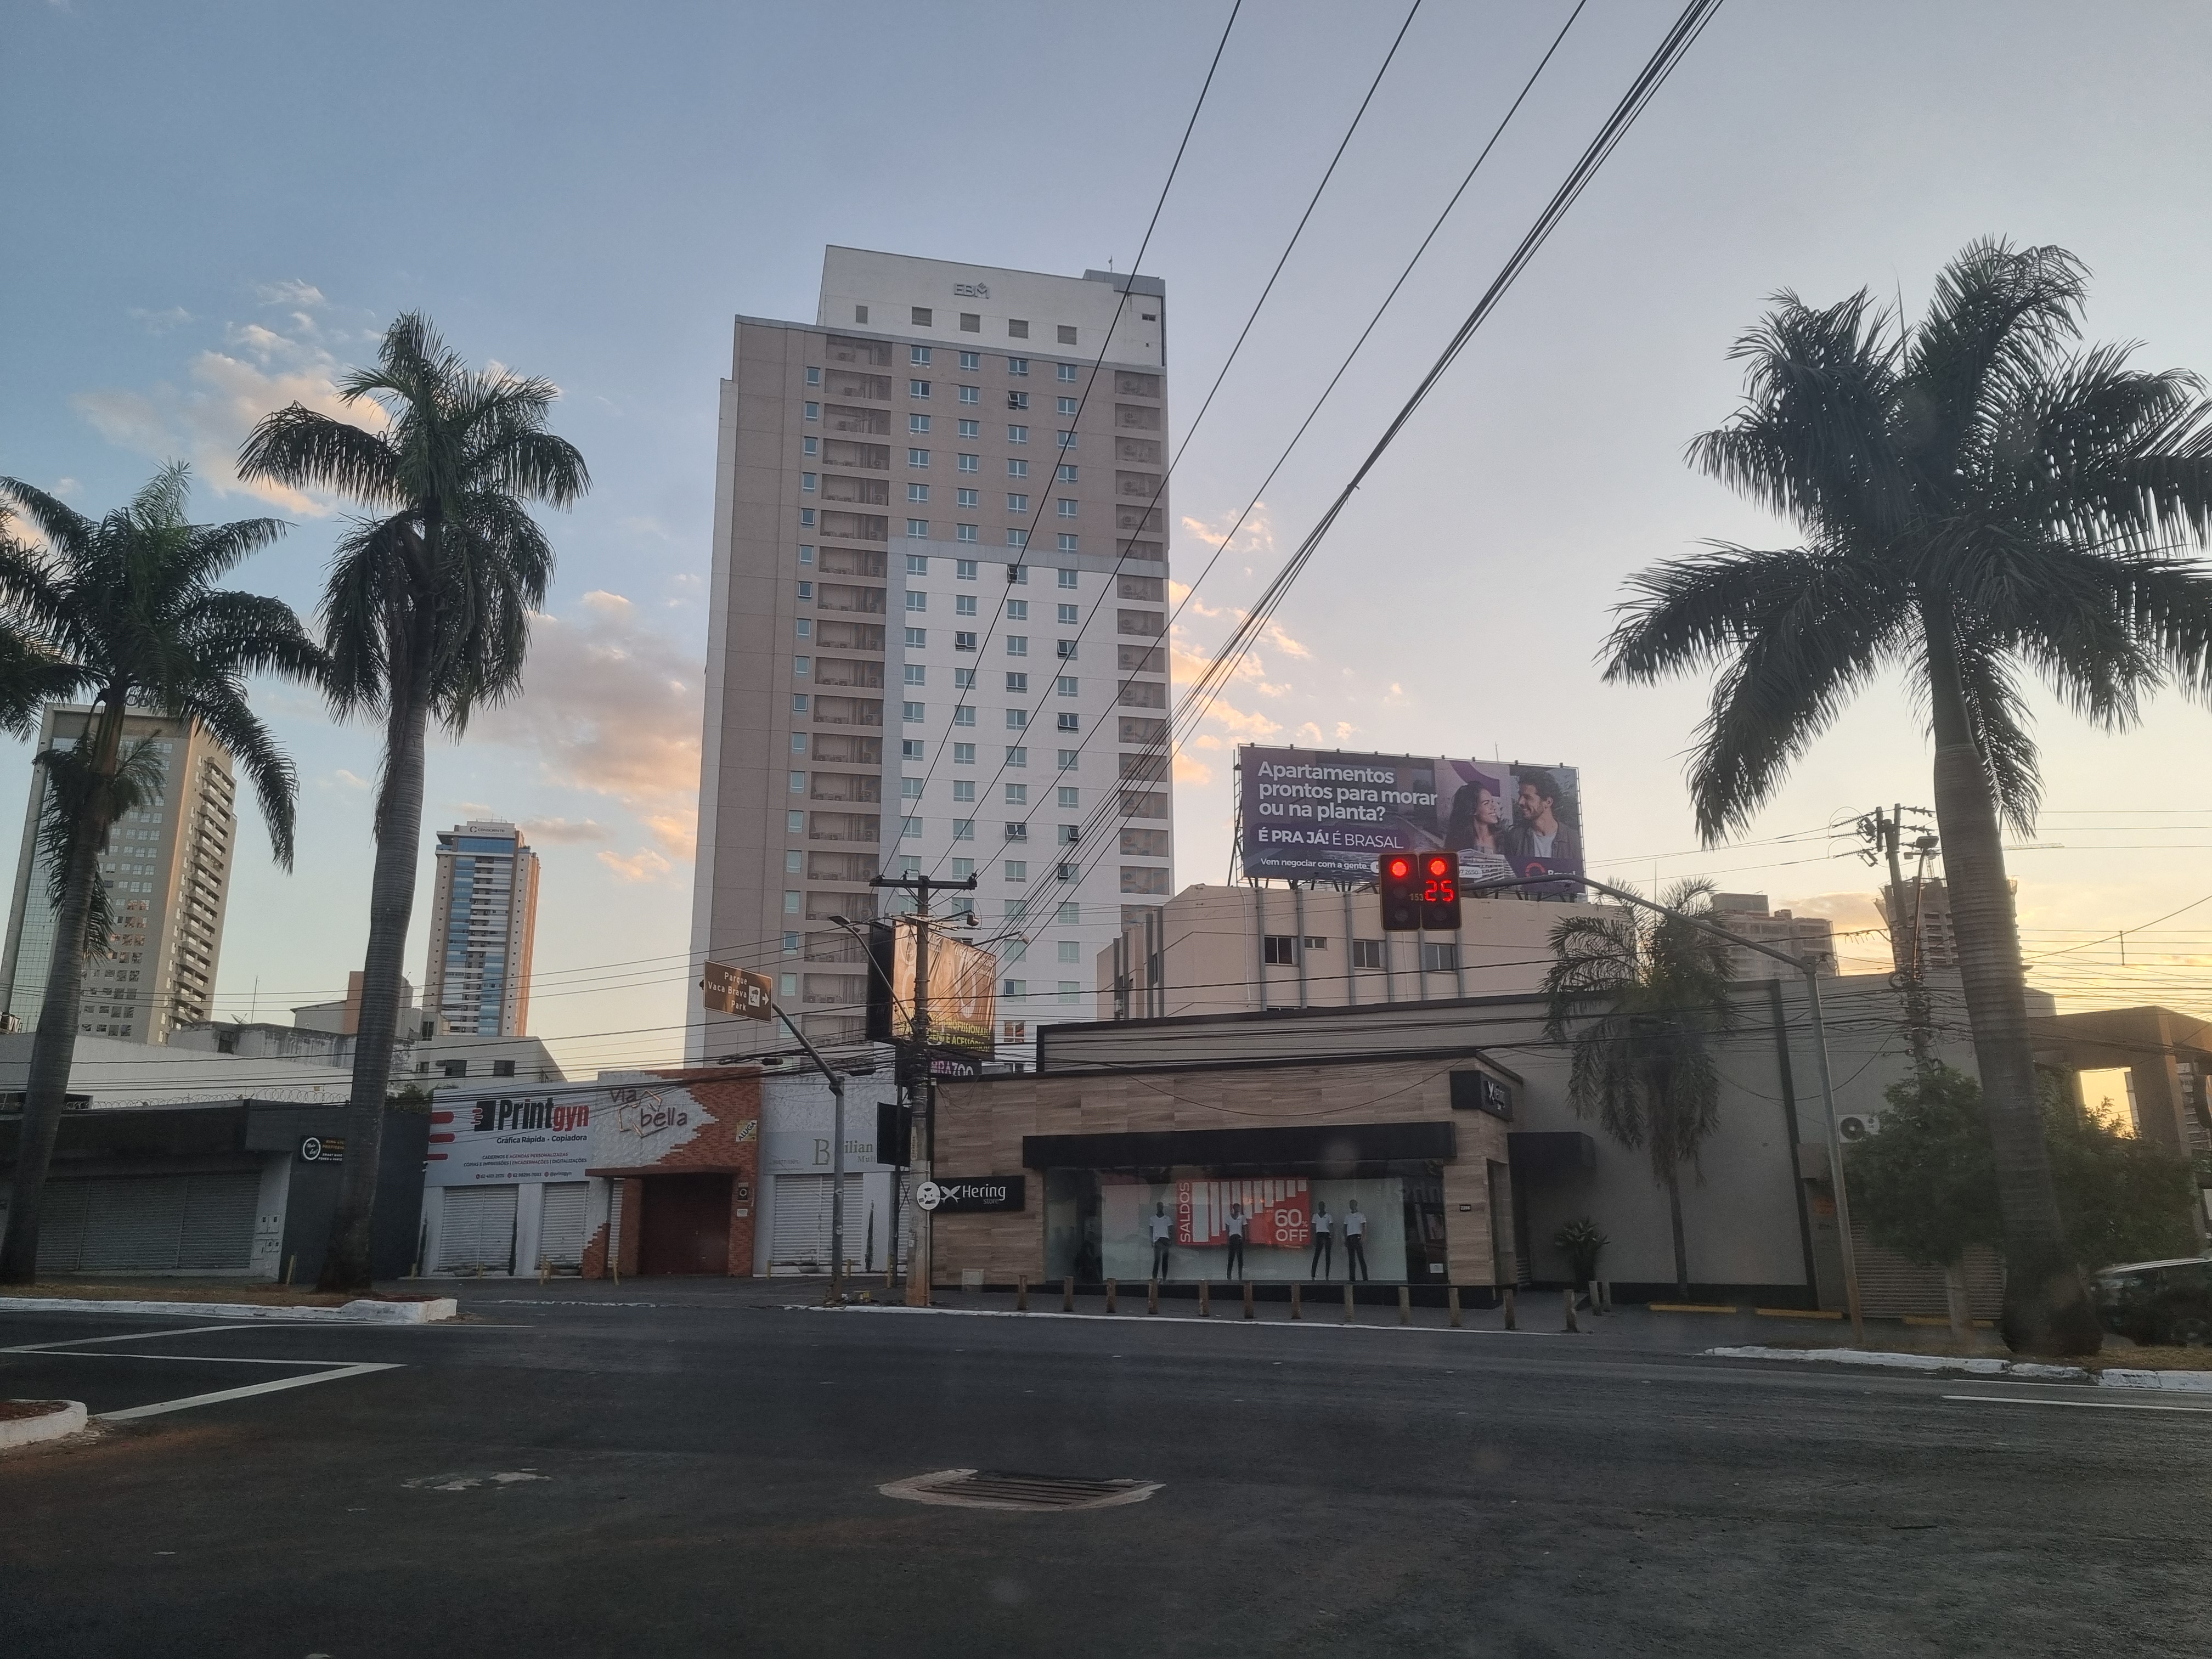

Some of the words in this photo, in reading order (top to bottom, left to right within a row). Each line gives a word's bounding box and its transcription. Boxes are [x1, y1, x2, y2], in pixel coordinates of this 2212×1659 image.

[1258, 761, 1395, 784] Apartamentos
[1260, 783, 1333, 799] prontos
[1337, 787, 1378, 804] para
[1381, 790, 1438, 805] morar
[1259, 803, 1284, 816] ou
[1289, 804, 1312, 817] na
[1317, 802, 1386, 822] planta?
[1258, 826, 1268, 842] É
[1272, 830, 1304, 843] PRA
[1306, 830, 1329, 844] JÁ!
[1333, 831, 1342, 845] É
[1345, 833, 1404, 849] BRASAL
[1261, 857, 1279, 866] Vem
[1281, 859, 1316, 868] negociar
[1410, 893, 1424, 901] 153
[1425, 879, 1455, 902] 25
[724, 972, 748, 985] Parque
[708, 981, 725, 993] Vaca
[728, 986, 747, 998] Brava
[731, 1000, 747, 1011] Park
[498, 1097, 589, 1132] Printgyn
[640, 1107, 687, 1127] bella
[496, 1136, 521, 1144] Gráfica
[522, 1136, 545, 1144] Rápida
[551, 1134, 588, 1143] Copiadora
[738, 1121, 757, 1141] ALUGA
[962, 1184, 1007, 1201] Hering
[1180, 1182, 1190, 1243] SALDOS
[1276, 1229, 1308, 1242] OFF
